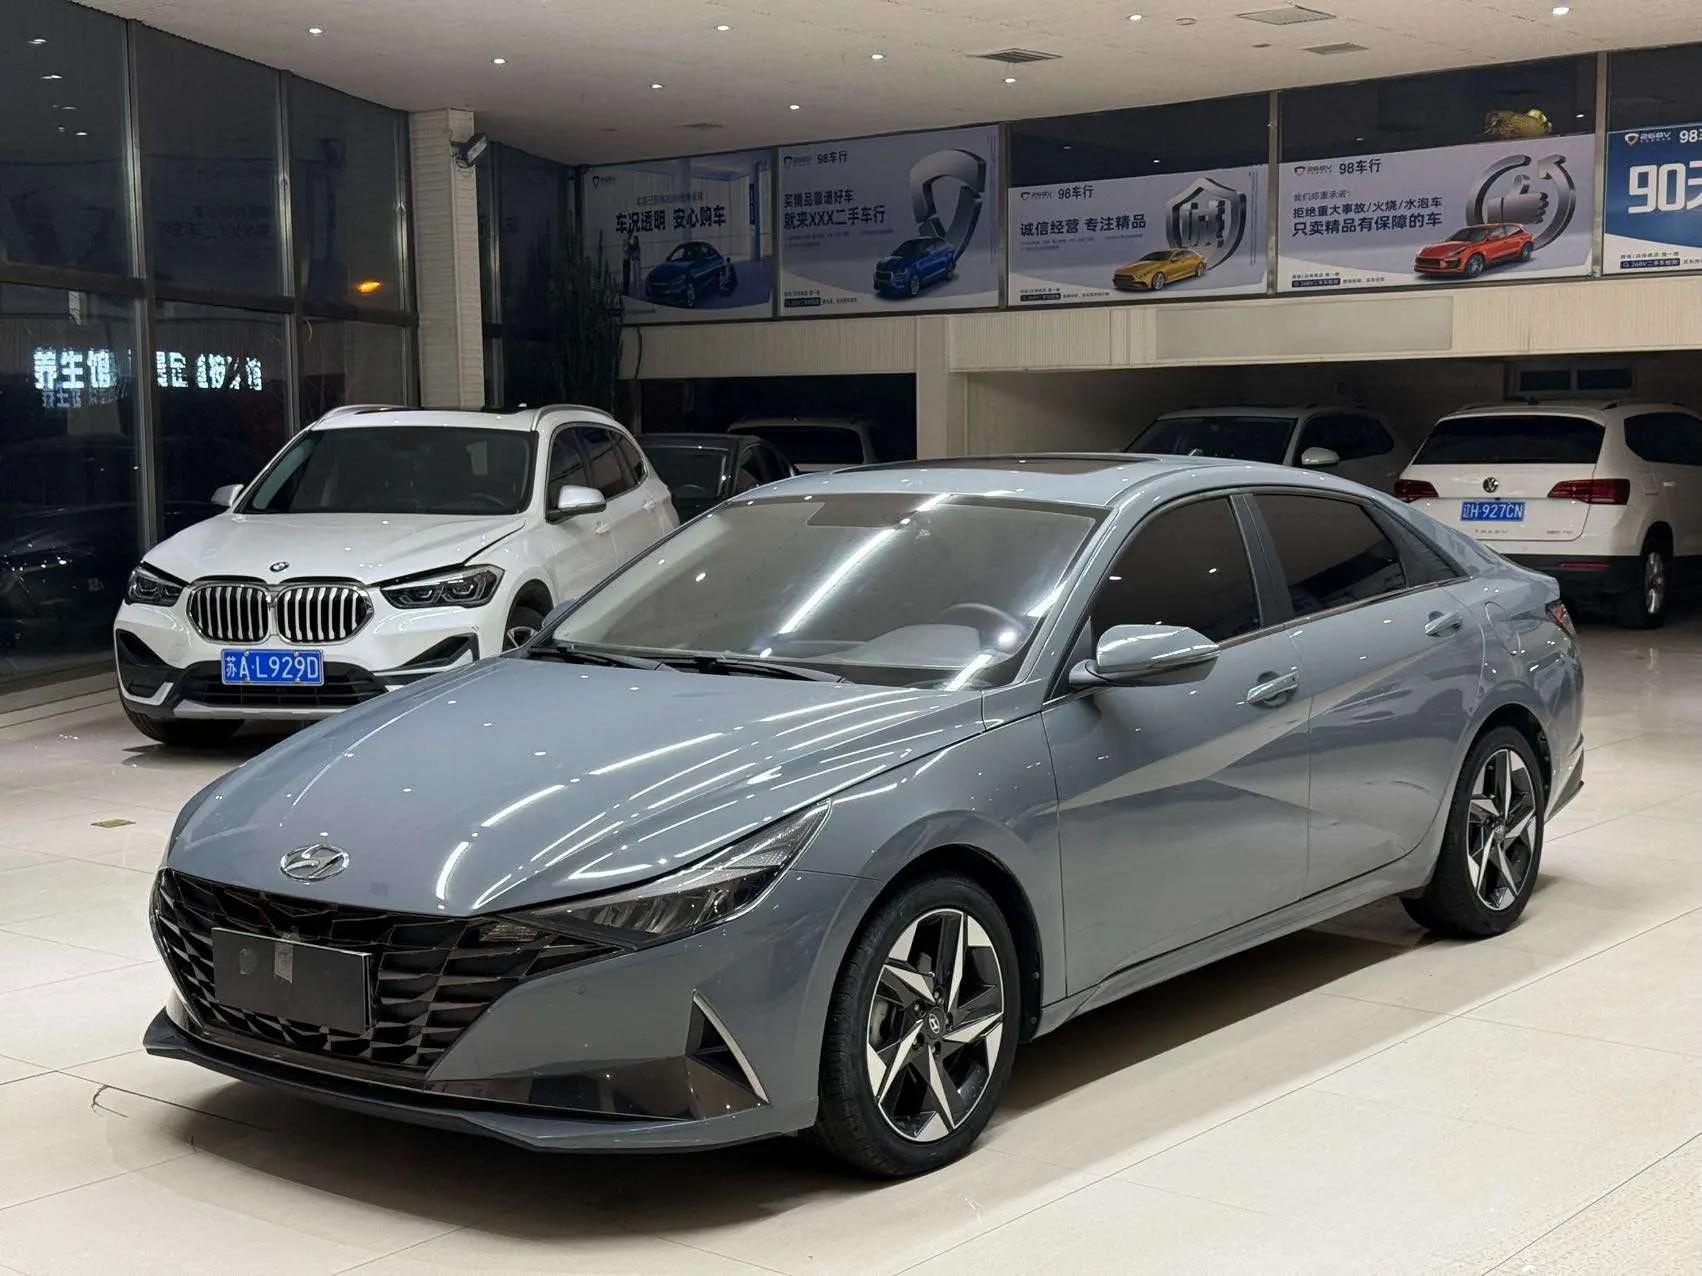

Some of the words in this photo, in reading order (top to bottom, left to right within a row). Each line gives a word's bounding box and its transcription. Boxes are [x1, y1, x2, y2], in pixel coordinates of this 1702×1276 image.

[816, 150, 848, 165] 98车行
[1338, 158, 1382, 175] 98车行
[1058, 185, 1094, 200] 98车行
[615, 209, 666, 234] 车况透明
[672, 204, 726, 230] 安心购车
[784, 204, 886, 231] 就来XXX二手车行
[1293, 196, 1442, 218] 拒绝重大事故/火烧/水泡车
[1020, 218, 1080, 237] 诚信经营
[1085, 213, 1147, 233] 专注精品
[1292, 212, 1442, 237] 只卖精品有保障的车
[33, 347, 112, 390] 养生馆
